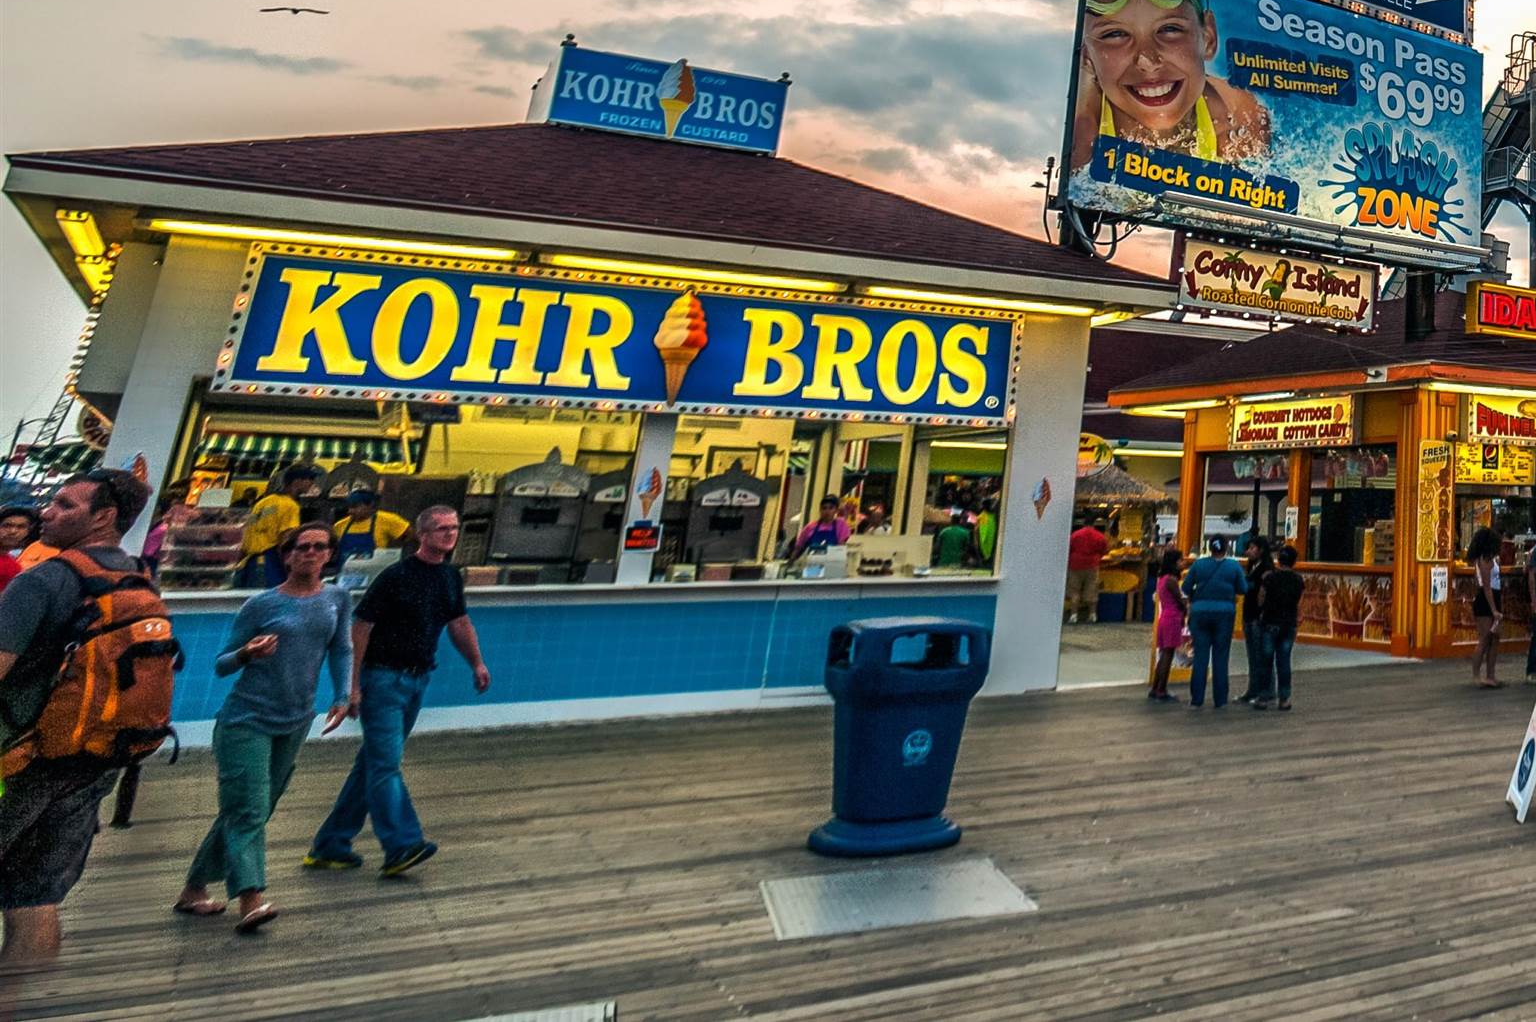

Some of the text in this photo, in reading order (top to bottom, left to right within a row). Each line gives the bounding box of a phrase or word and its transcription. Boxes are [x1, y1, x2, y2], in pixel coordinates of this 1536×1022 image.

[1233, 51, 1349, 80] Unlimited Visits
[1394, 36, 1467, 86] Pass
[559, 69, 778, 130] KOHR BROS
[1250, 72, 1338, 96] All Summer!
[600, 112, 750, 144] FROZEN CUSTARD
[1344, 122, 1458, 199] SPLASH
[1104, 150, 1287, 211] 1 Block on Right
[1357, 186, 1440, 238] ZONE
[1292, 266, 1361, 299] Island
[1202, 286, 1354, 320] Roasted Corn on the Cob
[256, 267, 991, 409] KOHR BROS
[1236, 422, 1348, 442] LEMONADE COTTON CANDY
[1252, 406, 1332, 425] GOURMET HOTDOGS
[1423, 446, 1450, 457] FRESH
